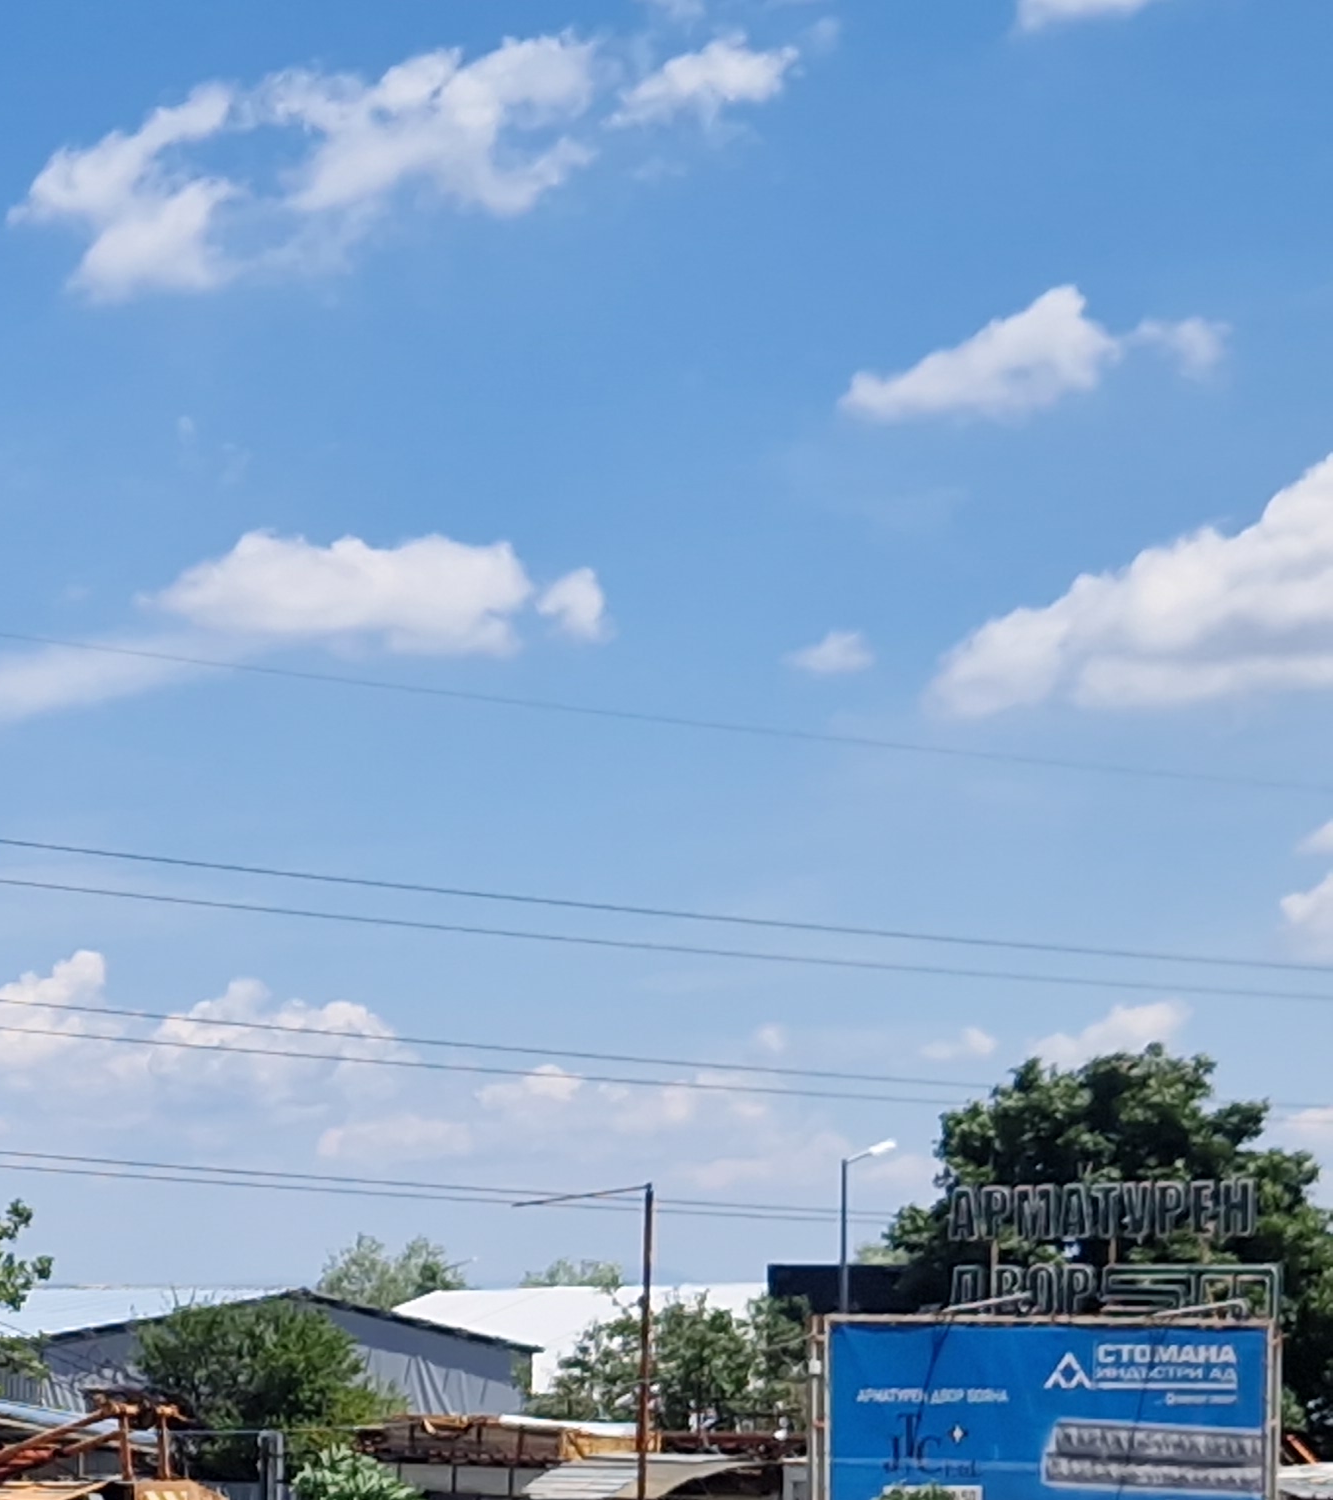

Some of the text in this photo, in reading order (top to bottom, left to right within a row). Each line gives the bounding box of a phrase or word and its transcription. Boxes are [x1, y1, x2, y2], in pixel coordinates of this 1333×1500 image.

[948, 1177, 1258, 1243] АРМАТУРЕН
[950, 1263, 1096, 1317] ДВОР
[1097, 1344, 1237, 1363] СТОМАНА
